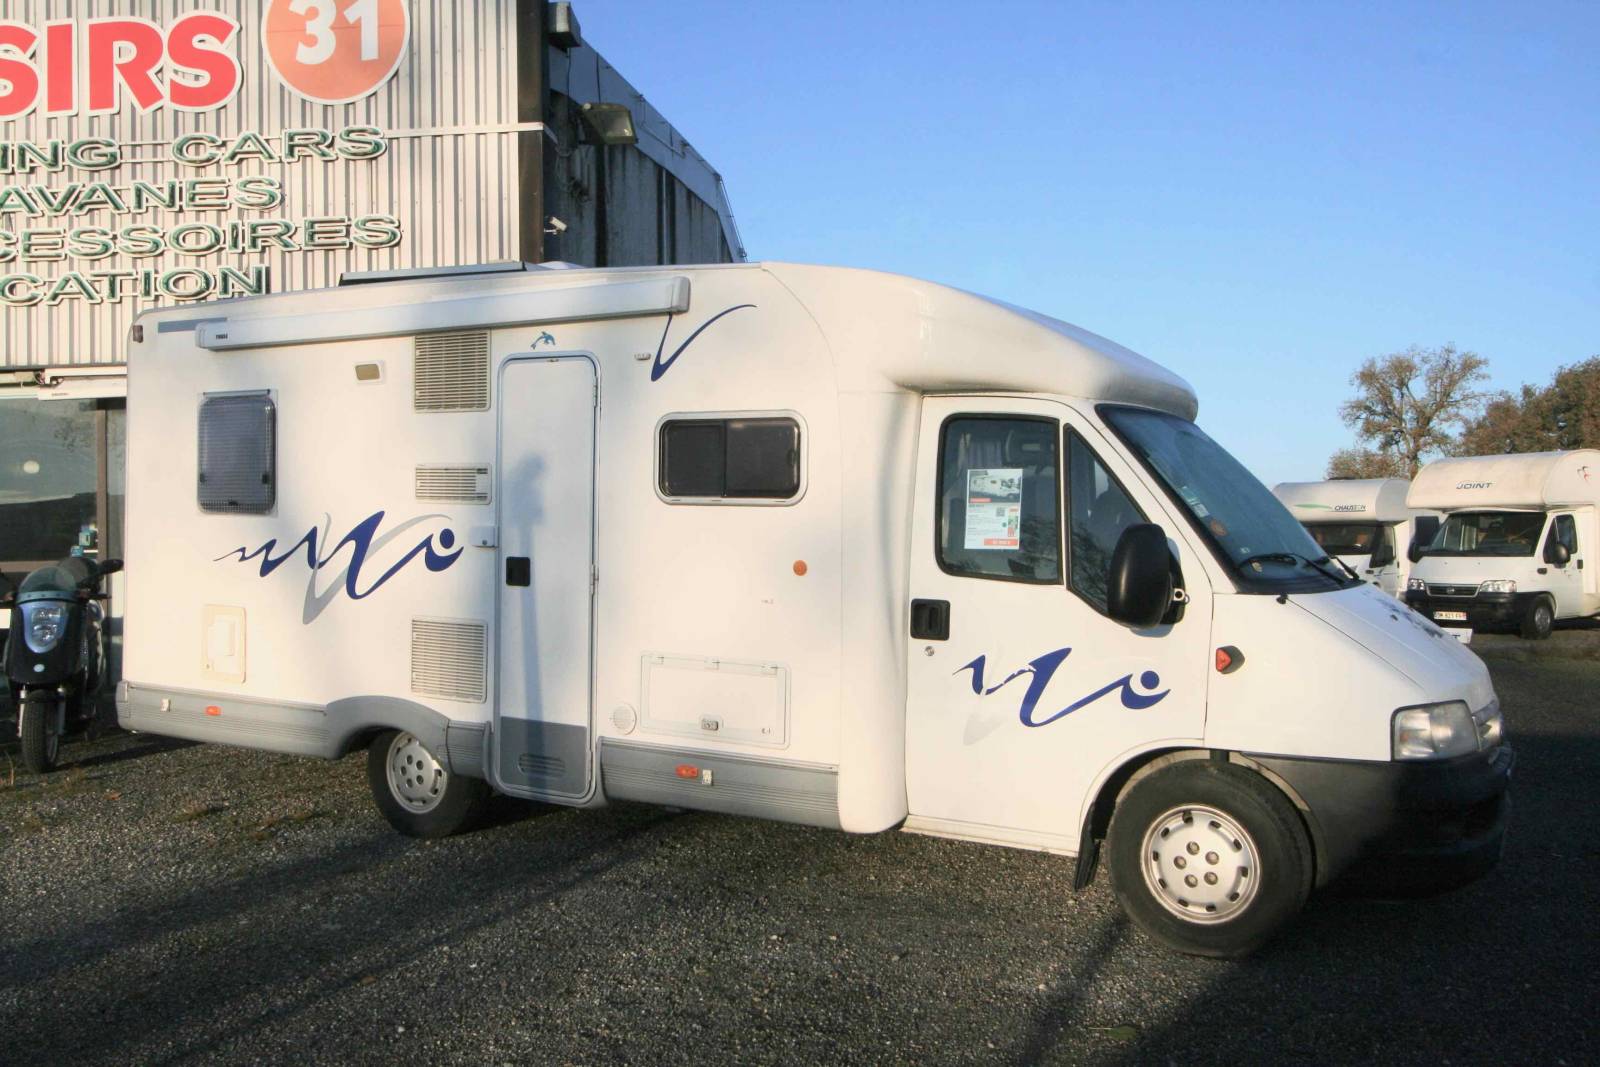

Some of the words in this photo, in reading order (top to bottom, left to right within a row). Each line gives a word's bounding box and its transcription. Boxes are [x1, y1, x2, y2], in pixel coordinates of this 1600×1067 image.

[288, 0, 378, 65] 31
[0, 14, 241, 120] SIRS
[0, 138, 120, 173] ING
[172, 126, 387, 166] CARS
[0, 176, 282, 217] AVANES
[0, 264, 269, 306] CATION
[1455, 481, 1495, 490] JOINT
